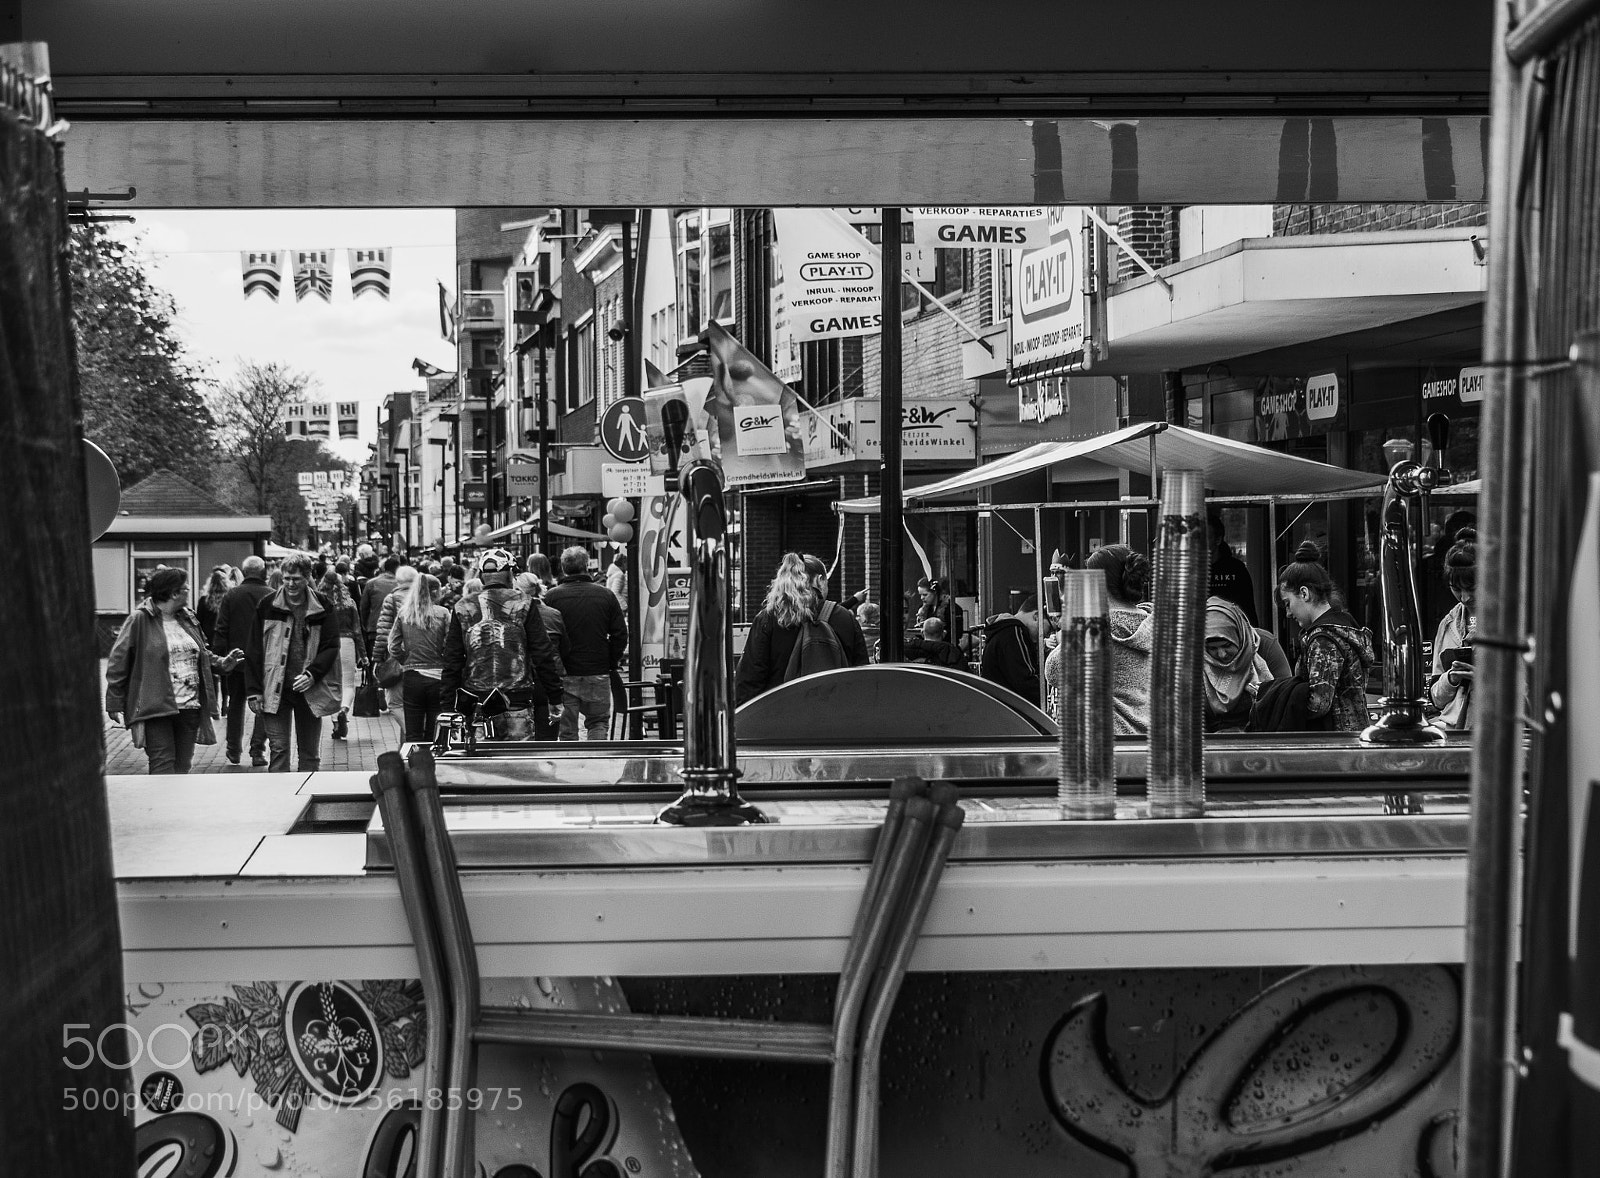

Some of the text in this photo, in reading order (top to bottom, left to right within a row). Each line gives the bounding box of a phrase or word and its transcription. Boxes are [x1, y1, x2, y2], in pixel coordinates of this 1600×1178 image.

[919, 207, 970, 215] VERKOOP
[979, 208, 1043, 217] REPARATIES
[937, 224, 1028, 244] GAMES
[807, 252, 835, 260] GAME
[809, 266, 864, 278] PLAY-IT
[1025, 251, 1067, 304] PLAY-IT
[806, 286, 836, 296] INRUIL
[791, 297, 833, 307] VERKOOP
[810, 314, 882, 334] GAMES
[1423, 379, 1457, 400] GAMESHOP
[1261, 385, 1335, 416] GAMESHOP PLAY-IT
[289, 405, 304, 416] Hi
[313, 404, 327, 416] Hi
[341, 403, 356, 415] Hi
[740, 415, 780, 429] G&W
[866, 437, 966, 447] GeheidsWinkel
[727, 470, 803, 482] GezondheidsWinkel.nl
